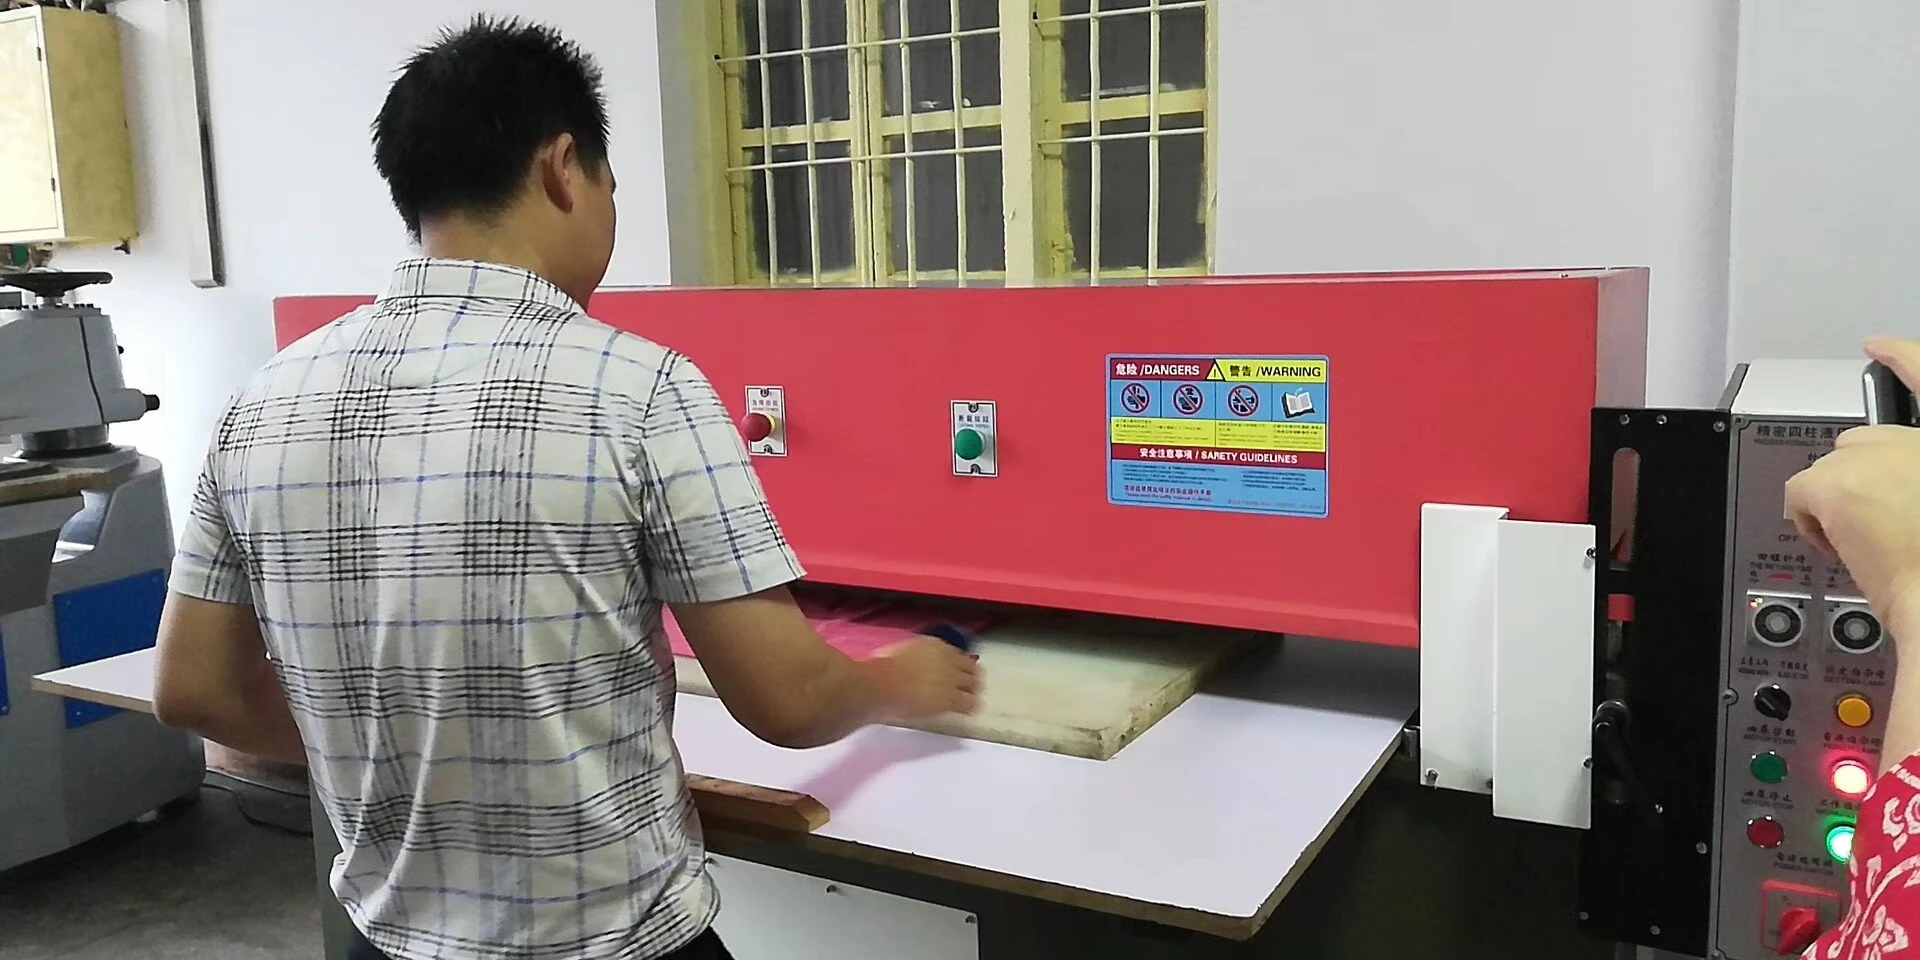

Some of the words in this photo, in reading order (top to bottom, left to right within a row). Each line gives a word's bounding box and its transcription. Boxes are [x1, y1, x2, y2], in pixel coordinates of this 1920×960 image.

[1140, 364, 1200, 376] /DANGERS
[1230, 365, 1251, 377] 警告
[1256, 366, 1321, 377] /WARNING
[1240, 453, 1298, 464] GUIDELINES
[1778, 534, 1799, 542] OFF
